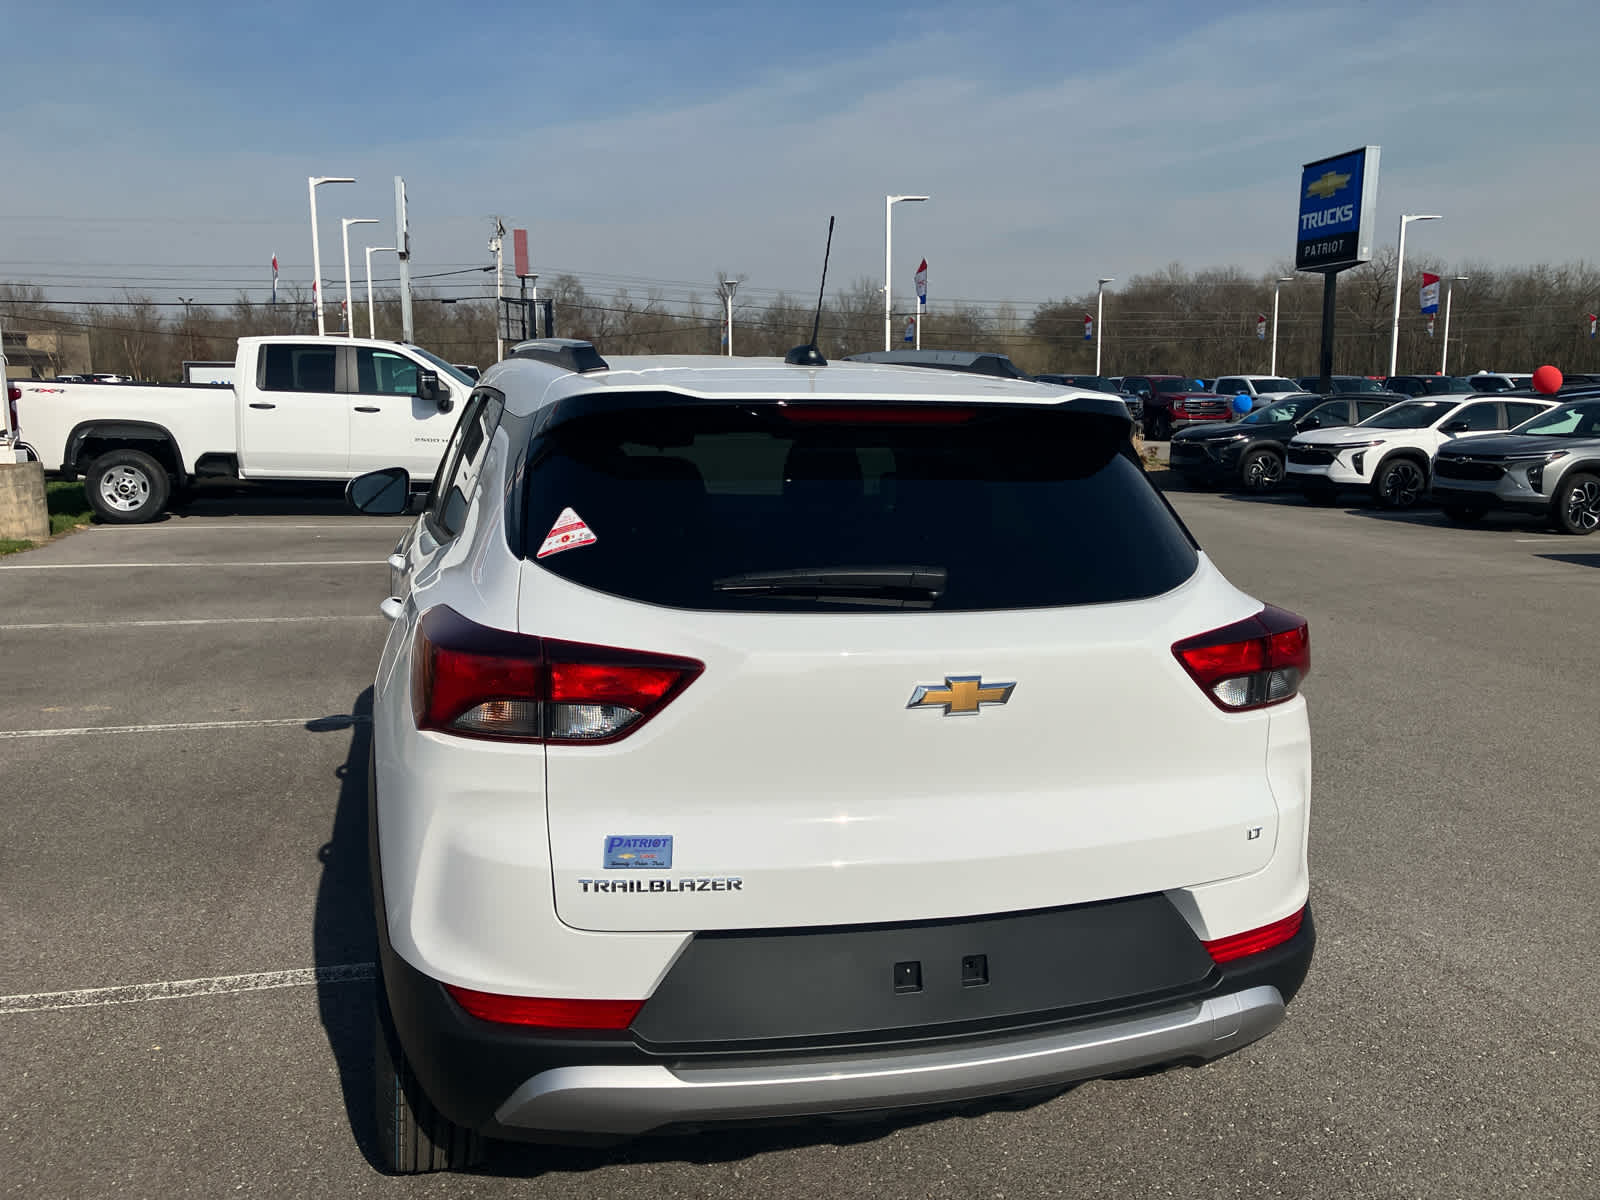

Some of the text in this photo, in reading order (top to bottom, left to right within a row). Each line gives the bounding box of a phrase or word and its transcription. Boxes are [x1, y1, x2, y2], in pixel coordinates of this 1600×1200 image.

[1301, 204, 1354, 230] TRUCKS
[1304, 239, 1345, 257] PATRIOT
[1247, 826, 1263, 841] LT
[578, 877, 743, 893] TRAILBLAZER
